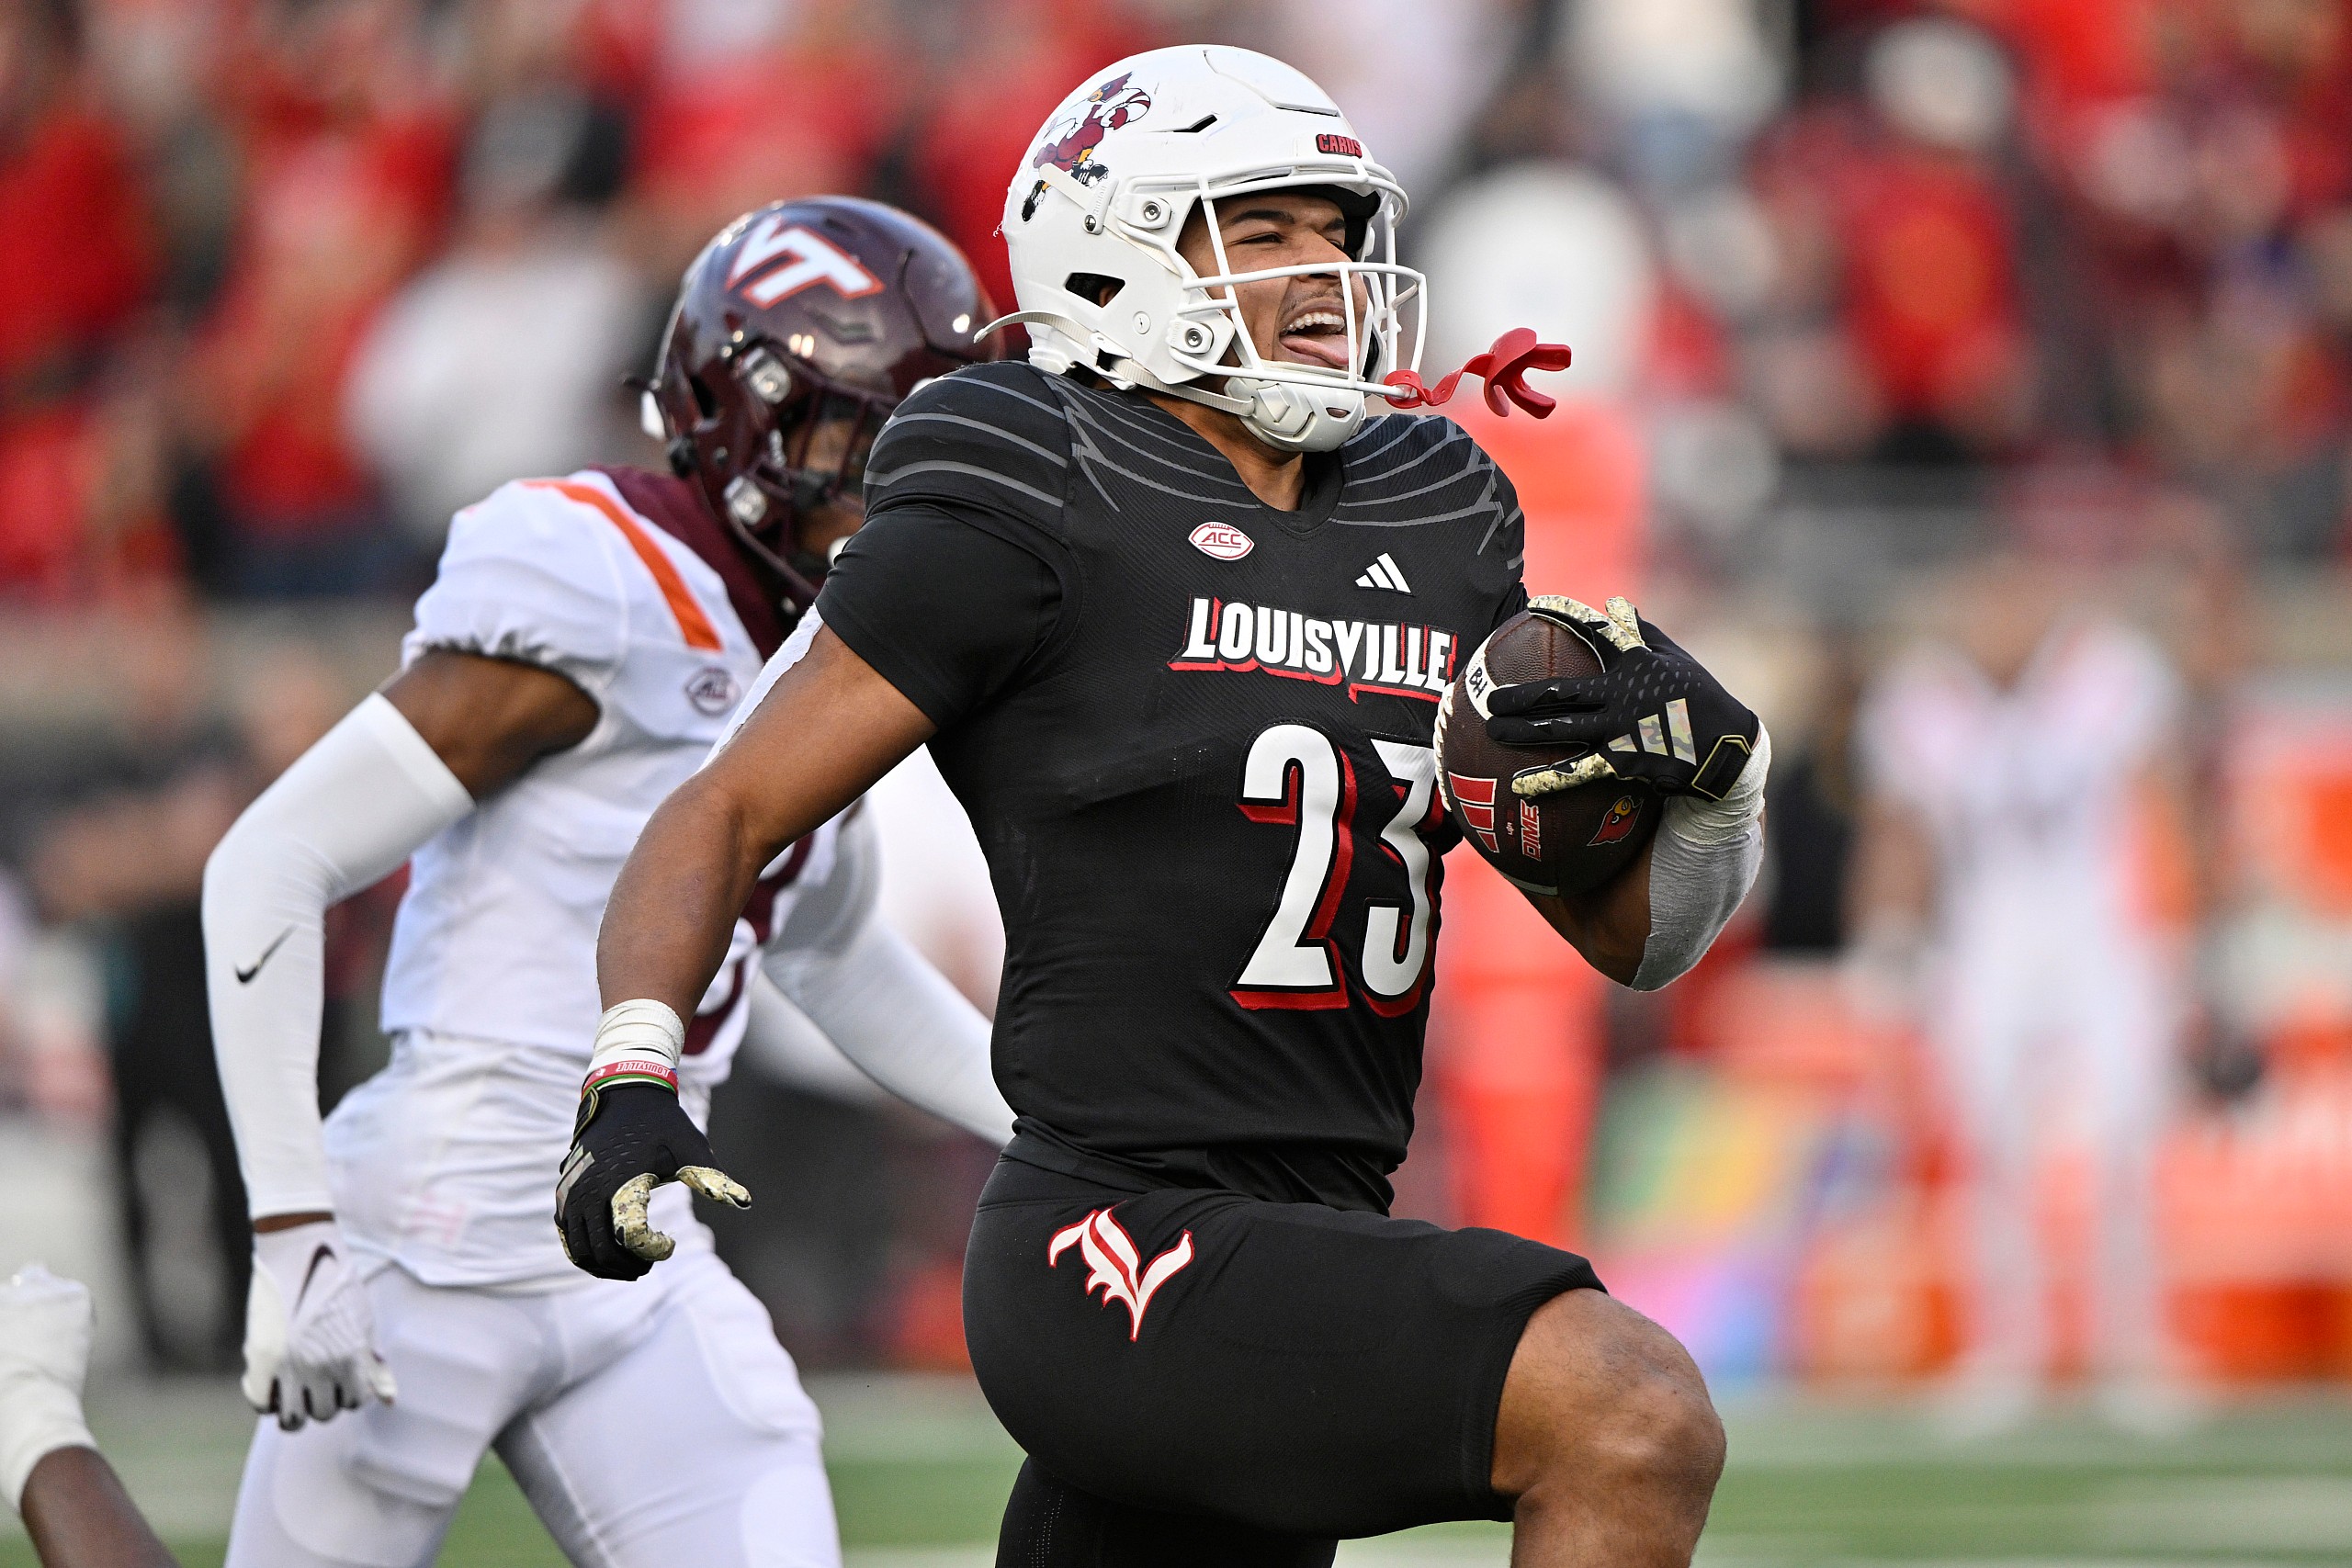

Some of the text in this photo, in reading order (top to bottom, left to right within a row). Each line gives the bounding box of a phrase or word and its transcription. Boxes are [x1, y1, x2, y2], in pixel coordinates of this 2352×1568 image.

[1316, 134, 1363, 159] CARDS
[1203, 532, 1242, 545] ACC
[1169, 597, 1458, 702] LOUISVILLE
[1521, 799, 1542, 862] DIME
[1229, 723, 1443, 1017] 23
[616, 1062, 671, 1077] LOUISVILLE
